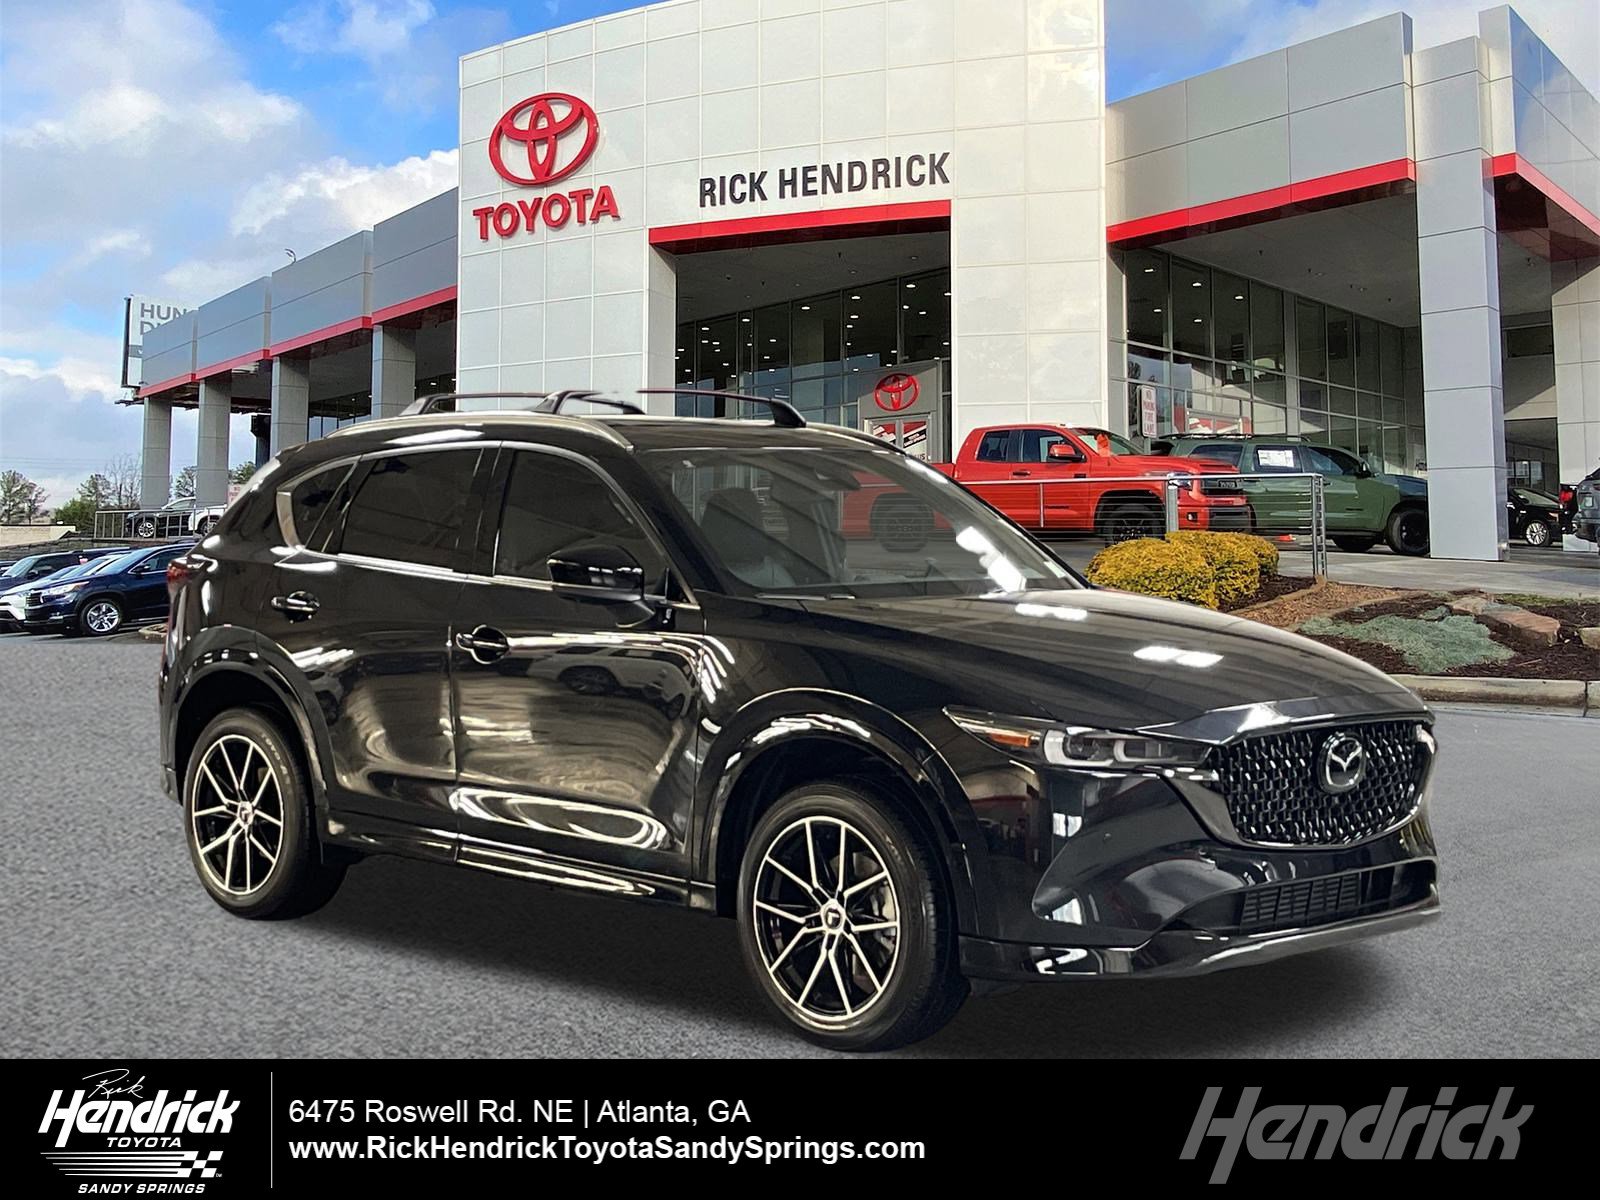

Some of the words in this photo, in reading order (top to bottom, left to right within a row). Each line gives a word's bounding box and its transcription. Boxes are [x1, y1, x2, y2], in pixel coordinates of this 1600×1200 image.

[699, 171, 768, 208] RICK
[779, 152, 951, 199] HENDRICK
[473, 186, 620, 240] TOYOTA
